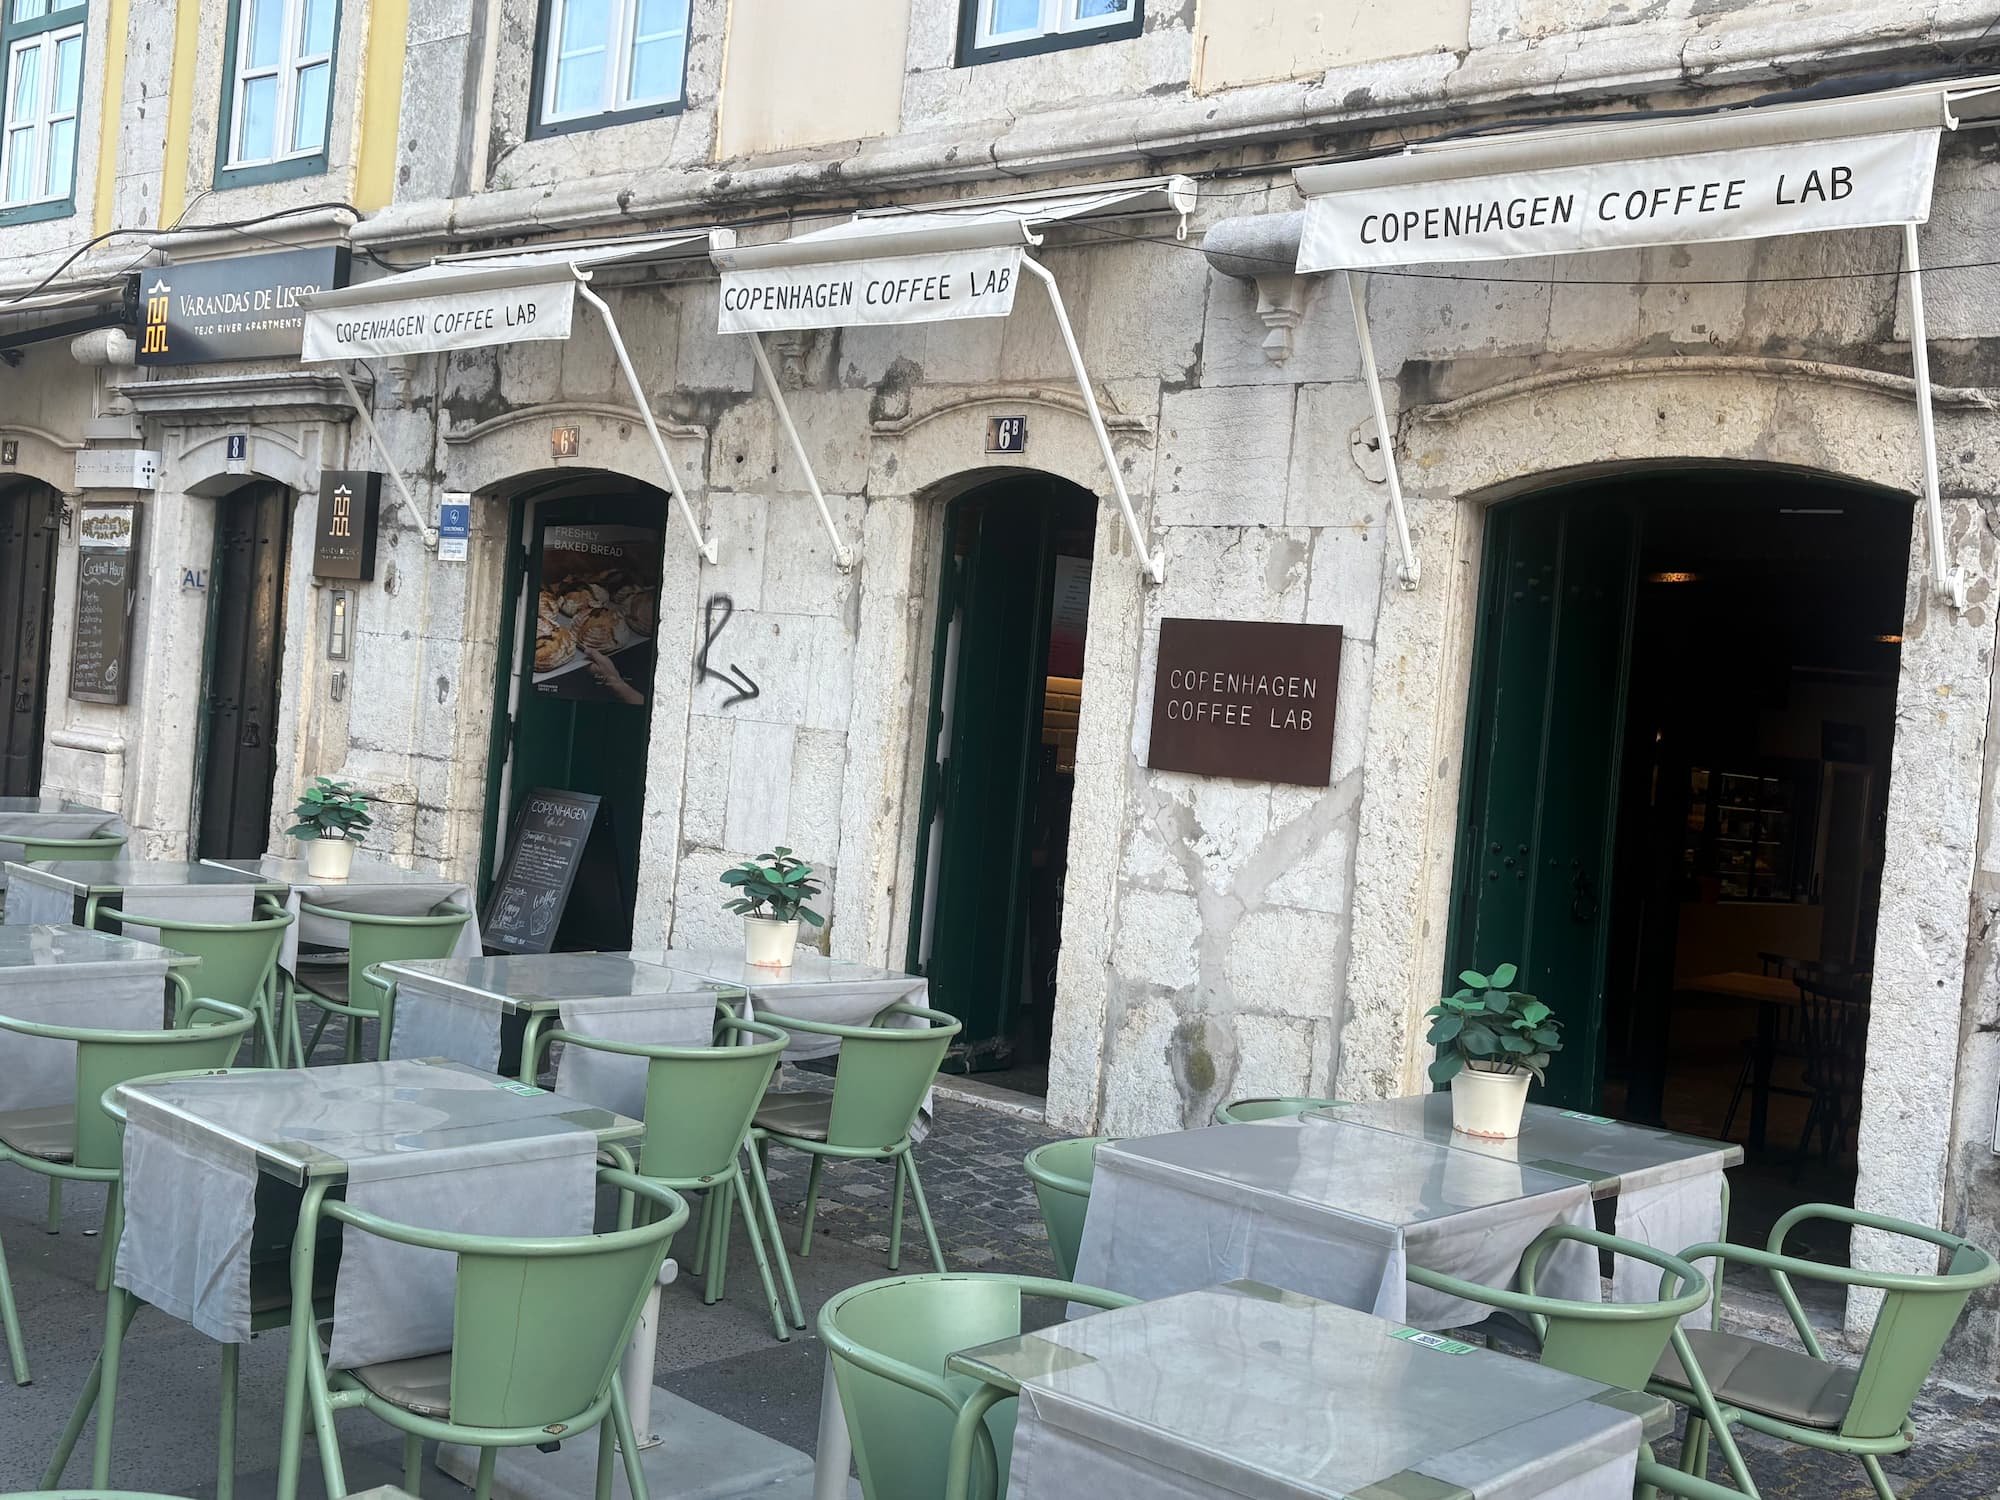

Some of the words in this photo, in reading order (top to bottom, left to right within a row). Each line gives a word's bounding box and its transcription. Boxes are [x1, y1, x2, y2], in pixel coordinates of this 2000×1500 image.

[1359, 193, 1574, 244] COPENHAGEN
[1598, 179, 1746, 221] COFFEE
[1775, 166, 1854, 205] LAB
[724, 280, 853, 311] COPENHAGEN
[866, 274, 951, 305] COFFEE
[970, 267, 1011, 297] LAB
[180, 291, 250, 317] VARANDAS
[254, 289, 272, 311] DE
[194, 325, 214, 336] TEJO
[217, 323, 242, 334] RIVER
[245, 317, 302, 332] APARTMENTS
[336, 314, 425, 343] COPENHAGEN
[433, 308, 494, 334] COFFEE
[505, 303, 537, 326] LAB
[232, 436, 240, 458] 8
[555, 526, 600, 541] FRESHLY
[554, 539, 589, 553] BAKED
[590, 545, 623, 558] BREAD
[183, 569, 206, 588] AL
[1170, 669, 1318, 699] COPENHAGEN
[1167, 699, 1253, 726] COFFEE
[1270, 708, 1314, 731] LAB
[531, 800, 589, 821] COPENHAGEN
